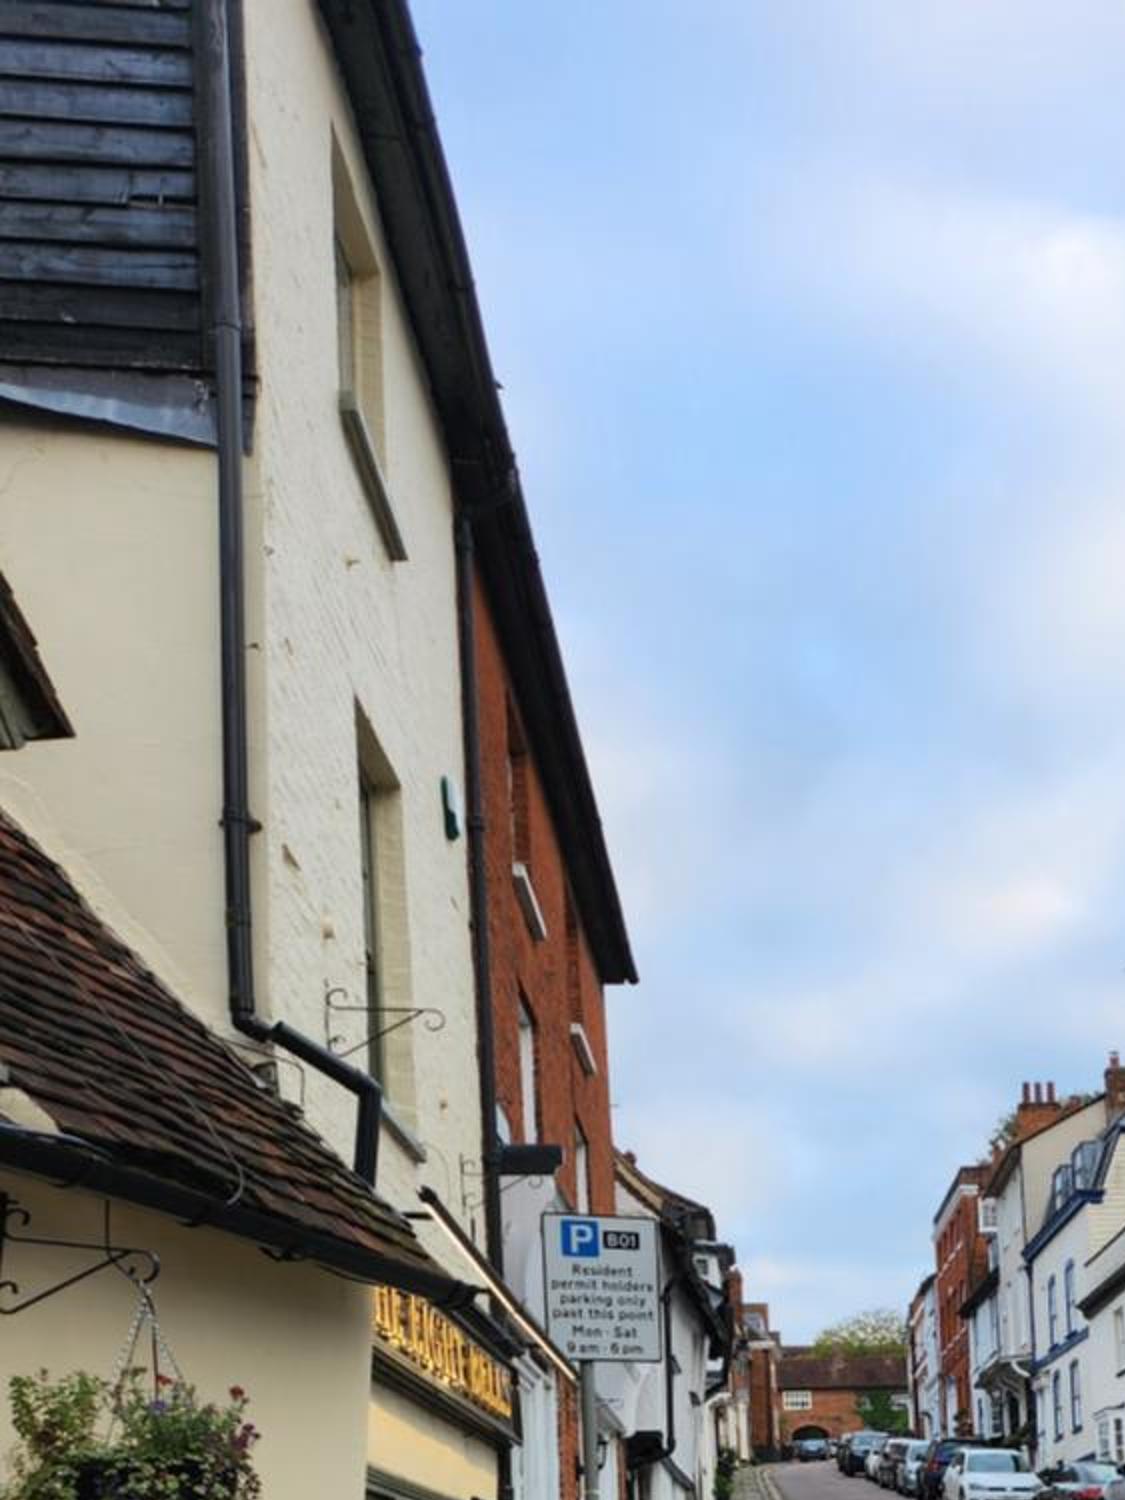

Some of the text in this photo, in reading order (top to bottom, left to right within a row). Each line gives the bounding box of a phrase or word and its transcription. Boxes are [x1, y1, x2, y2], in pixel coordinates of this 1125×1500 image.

[569, 1224, 593, 1253] P
[606, 1233, 638, 1248] B01
[572, 1264, 633, 1277] Resident
[551, 1279, 654, 1292] permit holders
[560, 1293, 647, 1308] parking only
[552, 1309, 653, 1323] past this point
[572, 1325, 602, 1338] Mon
[613, 1326, 637, 1339] Sat
[567, 1342, 576, 1353] 9
[579, 1344, 600, 1353] am
[610, 1343, 620, 1354] 6
[622, 1344, 643, 1356] pm
